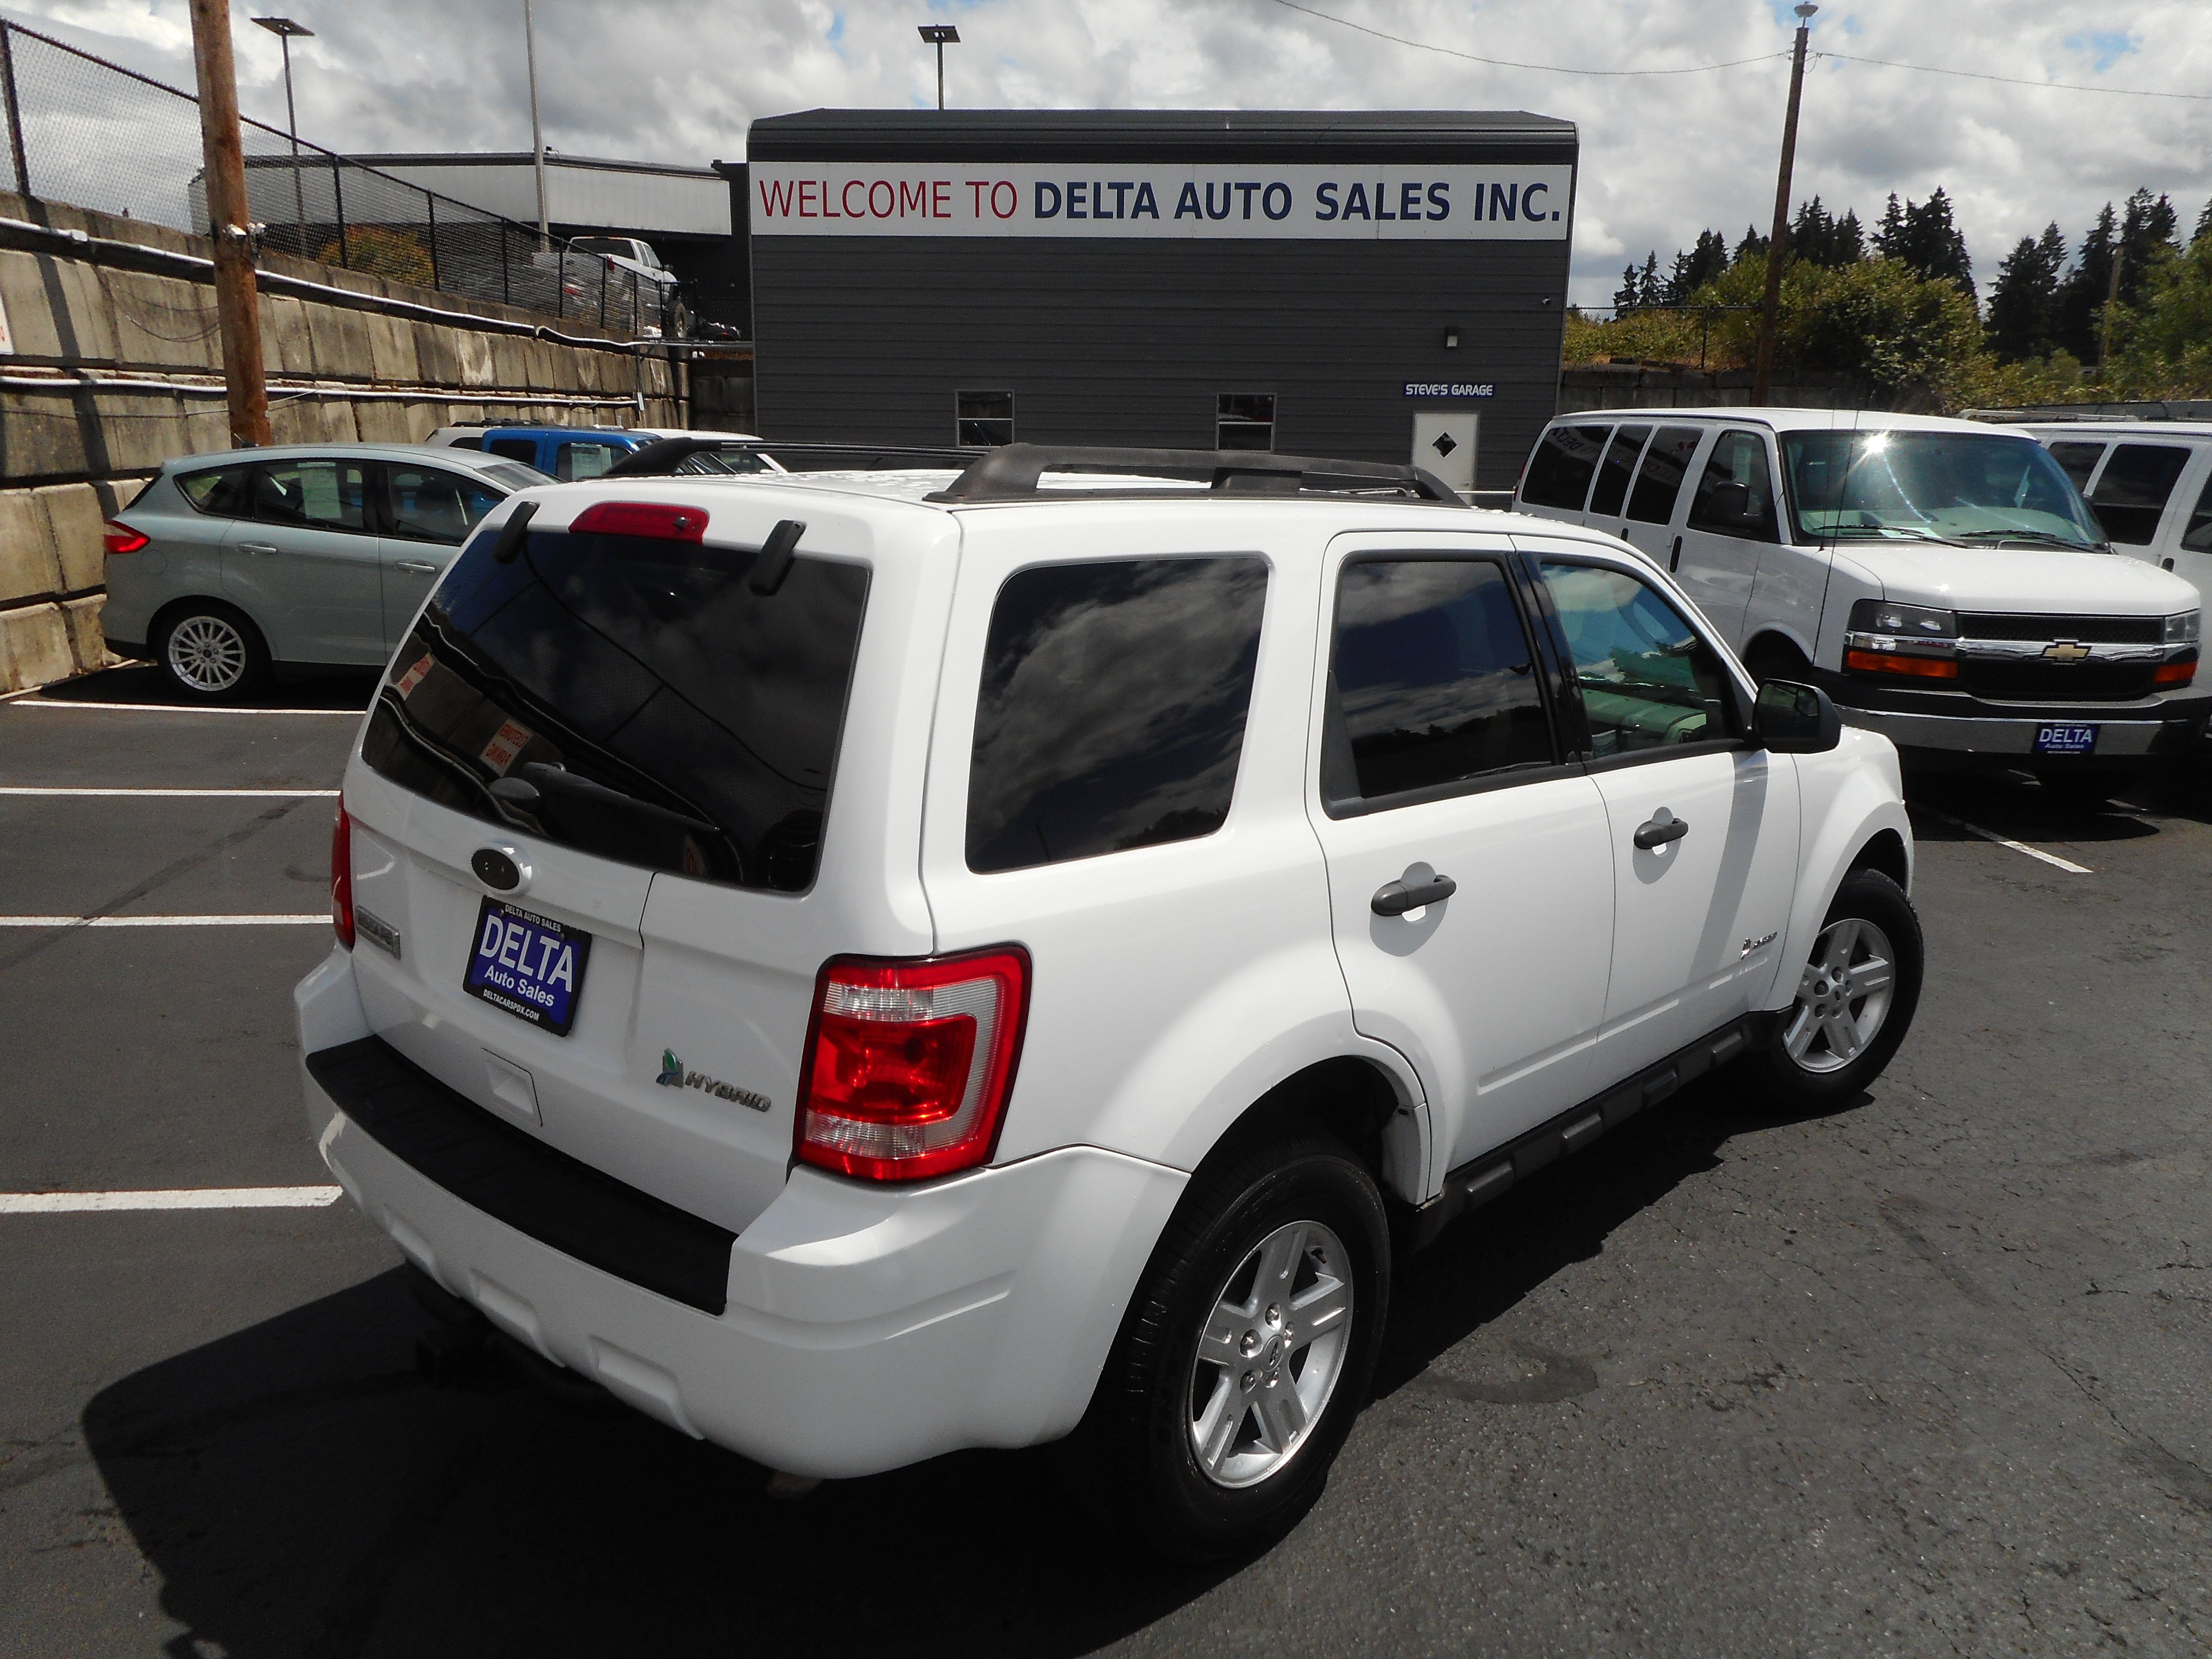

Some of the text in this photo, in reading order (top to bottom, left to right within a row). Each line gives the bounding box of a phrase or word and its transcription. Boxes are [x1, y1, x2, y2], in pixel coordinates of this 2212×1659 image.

[759, 180, 1560, 222] WELCOME TO DELTA AUTO SALES INC.
[1405, 383, 1493, 396] STEVE'S GARAGE
[2039, 728, 2092, 743] DELTA
[505, 904, 561, 933] DELTA AUTO SALES
[479, 914, 572, 993] DELTA
[483, 988, 539, 1021] DELTACARSPDX.COM
[484, 965, 555, 1007] Auto Sales
[684, 1070, 772, 1112] HYBRID
